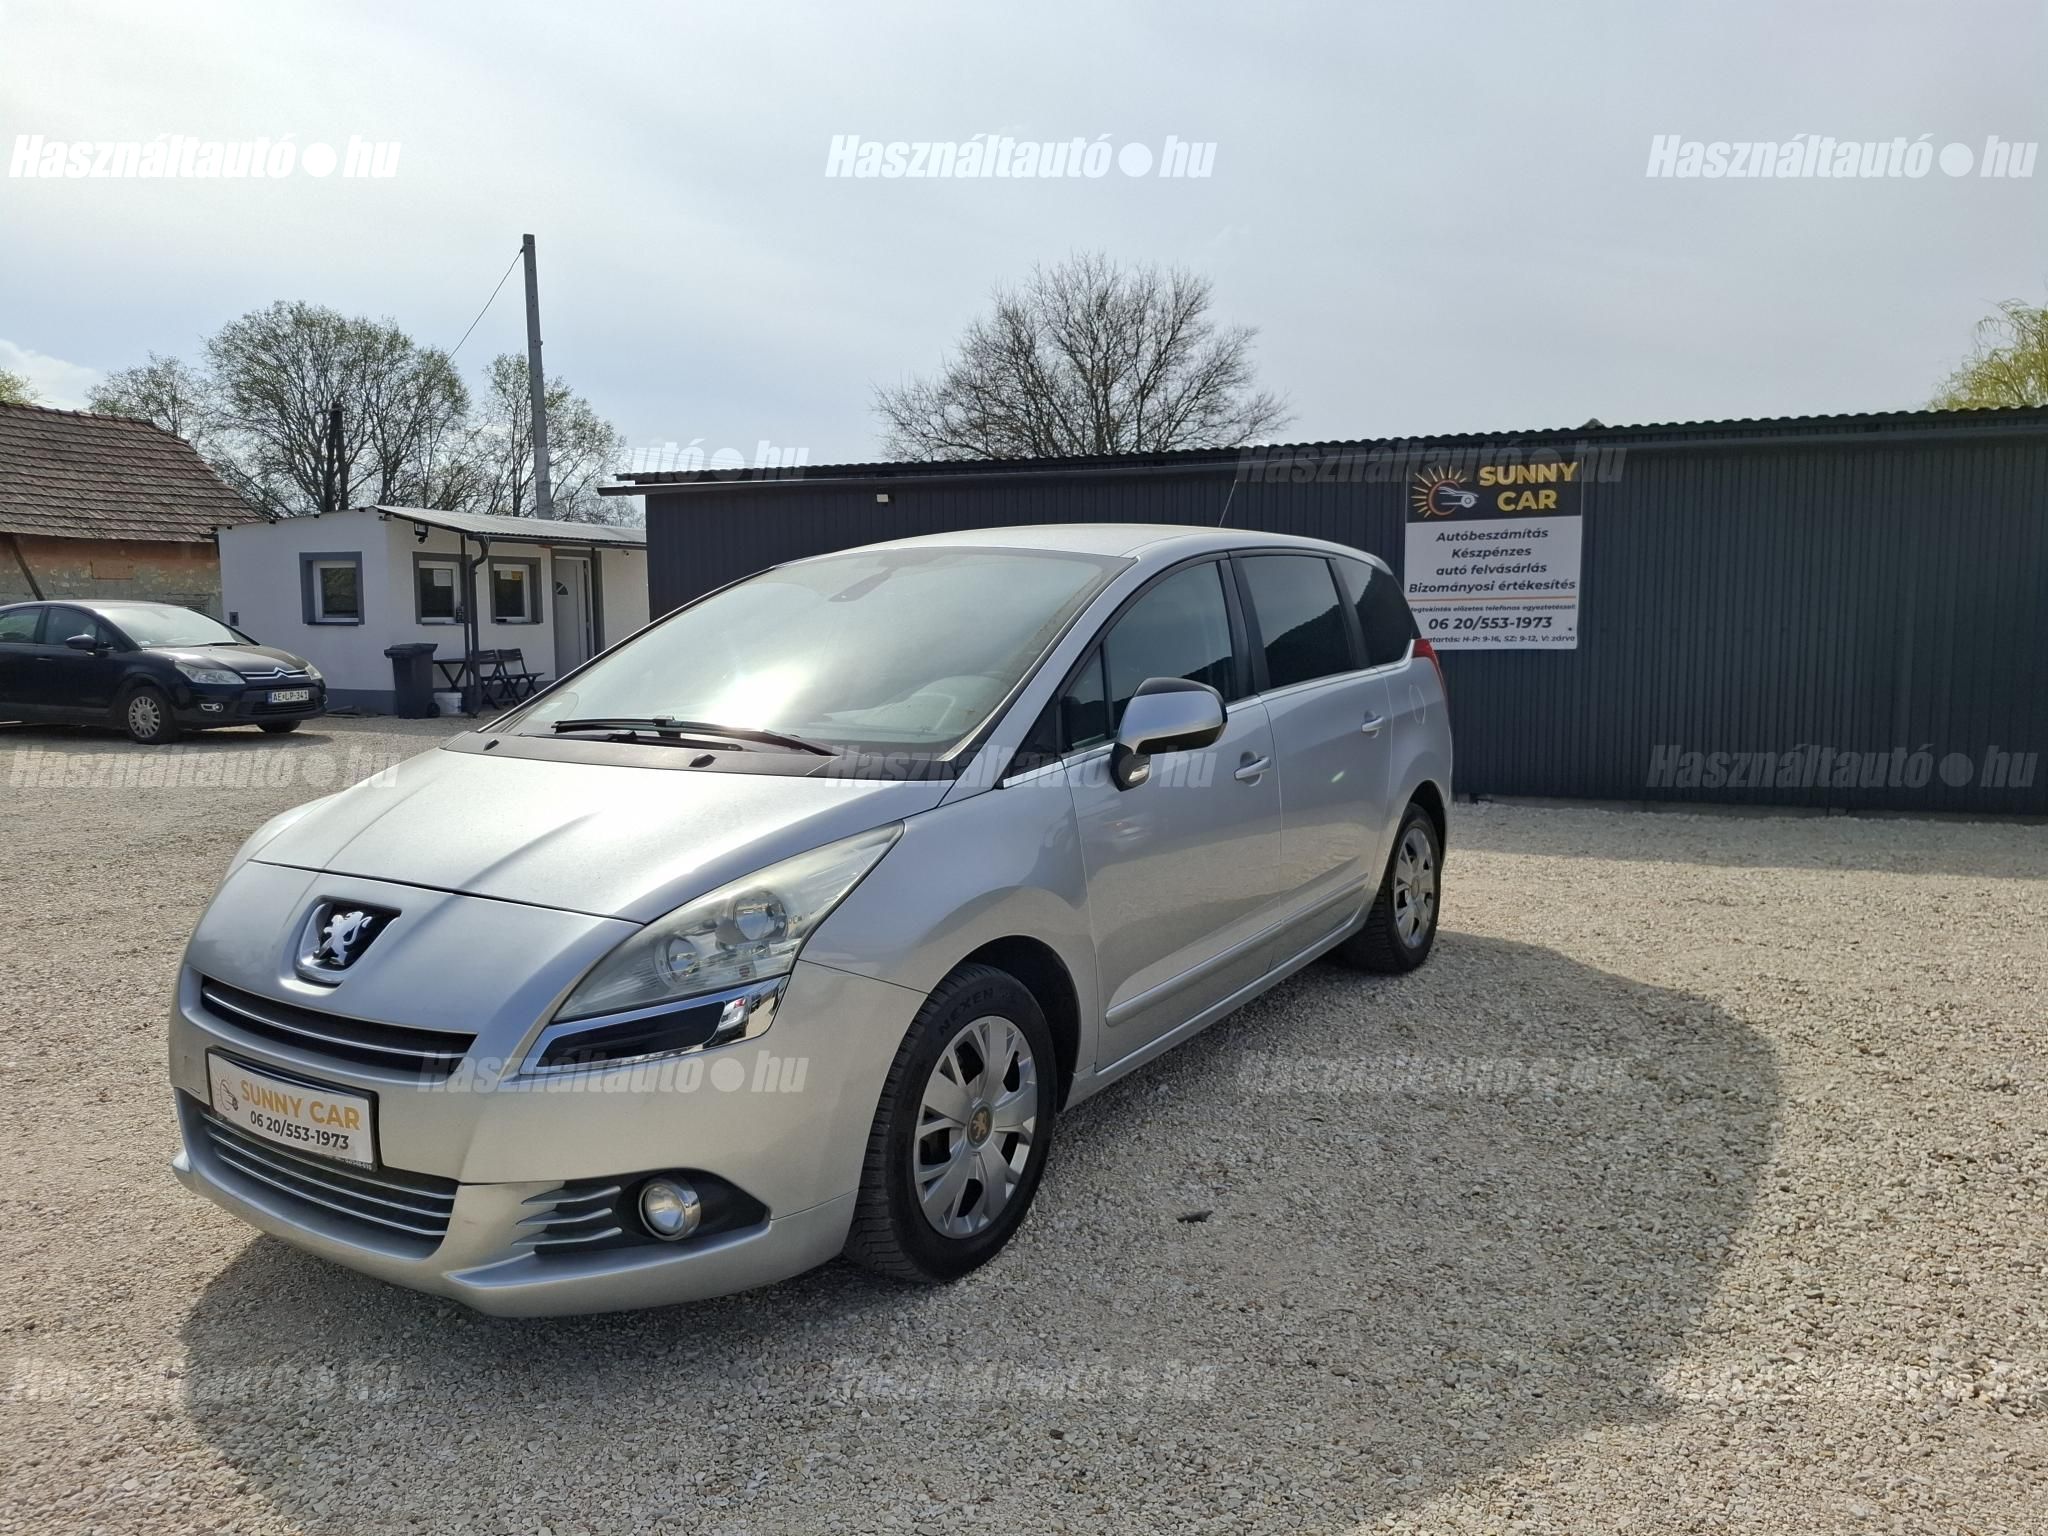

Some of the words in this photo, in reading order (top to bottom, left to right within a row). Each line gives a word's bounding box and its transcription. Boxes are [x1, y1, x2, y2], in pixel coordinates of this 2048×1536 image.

[1479, 462, 1578, 486] SUNNY
[1497, 490, 1557, 512] CAR
[1436, 528, 1549, 542] Autóbeszámítás
[1452, 547, 1532, 560] Készpénzes
[1436, 564, 1467, 576] autó
[1470, 563, 1547, 576] felvásárlás
[1409, 580, 1494, 594] Bizományosi
[1498, 579, 1576, 592] értékesítés
[1428, 618, 1449, 630] 06
[1453, 616, 1552, 631] 20/553-1973
[240, 1079, 304, 1118] SUNNY
[309, 1101, 361, 1131] CAR
[250, 1110, 264, 1127] 06
[266, 1116, 350, 1150] 20/553-1973
